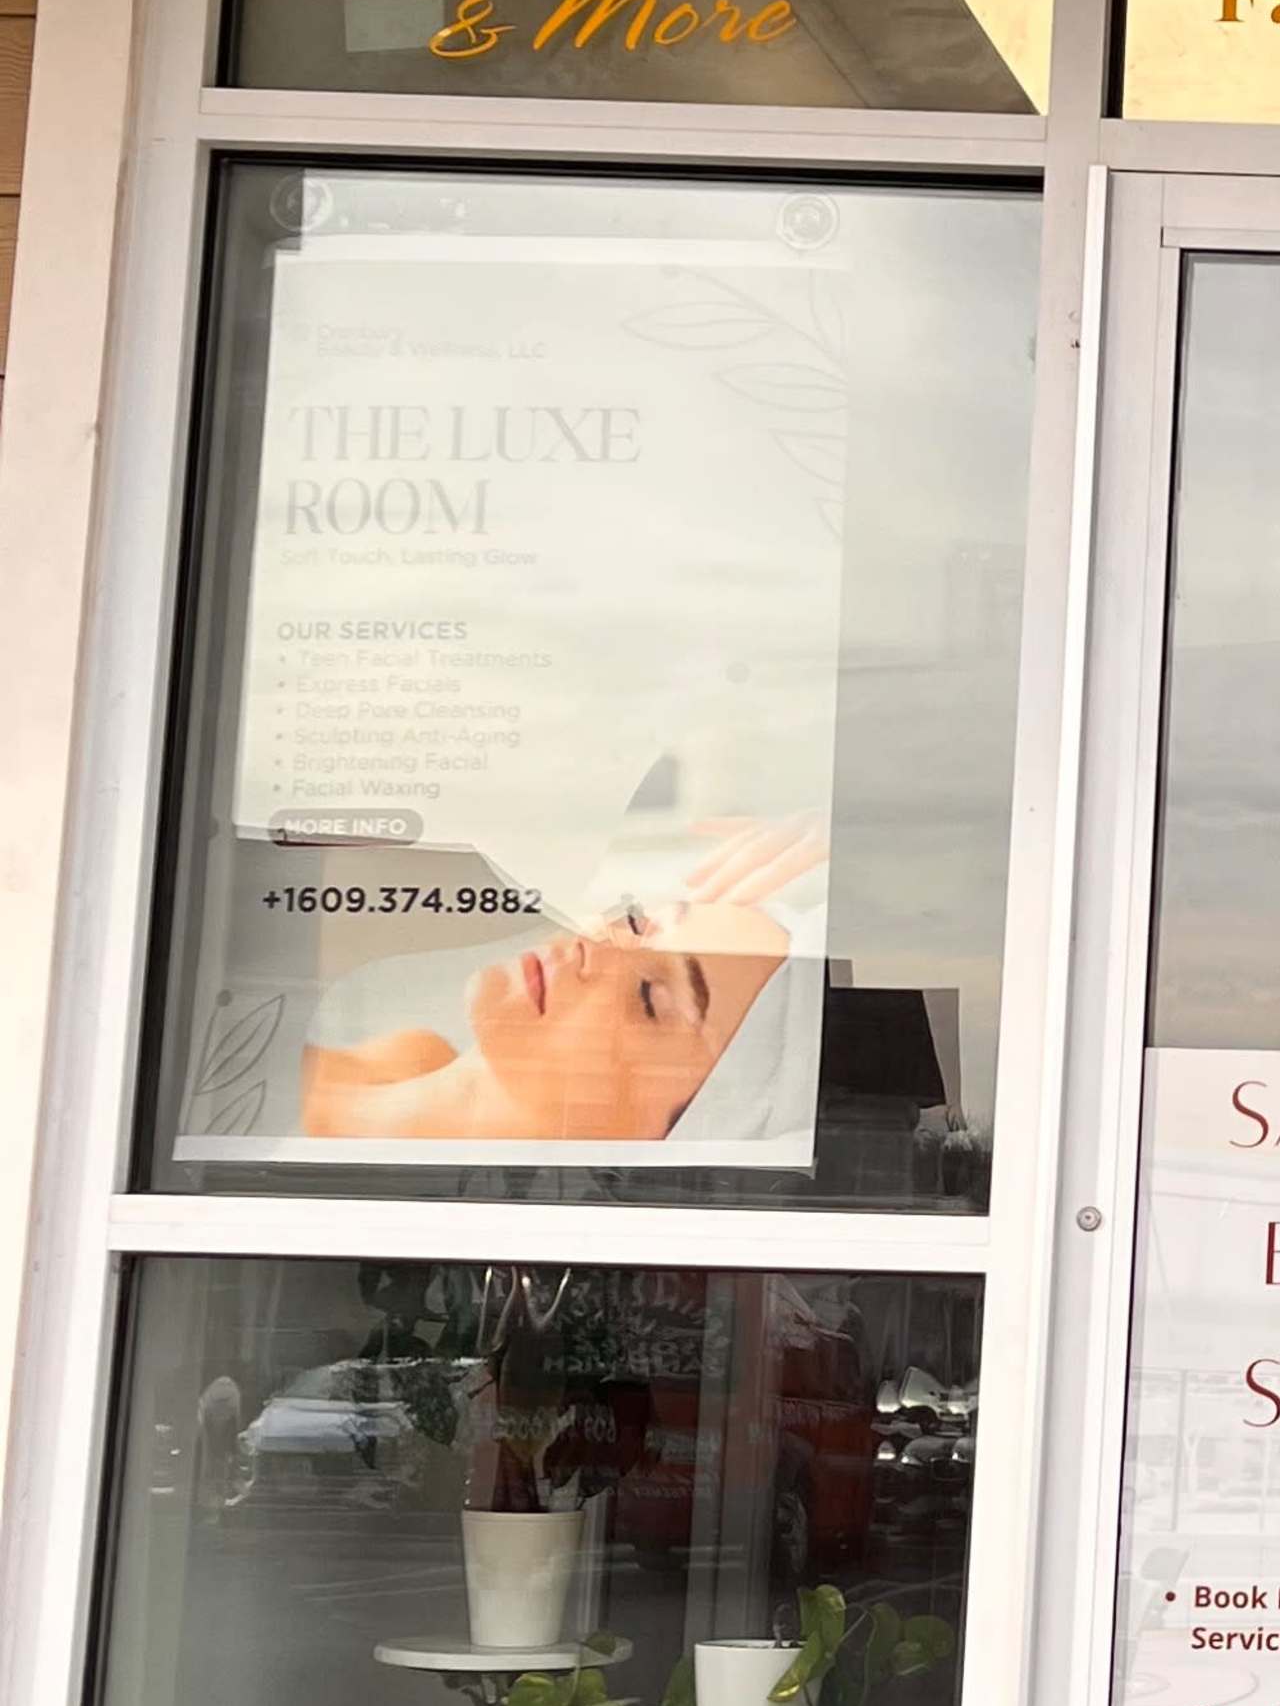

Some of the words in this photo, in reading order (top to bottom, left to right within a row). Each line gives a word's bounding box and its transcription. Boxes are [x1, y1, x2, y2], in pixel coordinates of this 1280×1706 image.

[293, 405, 430, 462] THE
[451, 405, 642, 463] LUXE
[286, 479, 491, 535] ROOM
[277, 622, 331, 640] OUR
[338, 621, 467, 640] SERVICES
[356, 649, 420, 667] Facial
[427, 650, 552, 668] Treatments
[296, 675, 379, 694] Express
[387, 675, 461, 693] Facials
[414, 701, 520, 724] Cleansing
[402, 728, 520, 750] Anti-Aging
[425, 753, 488, 770] Facial
[292, 779, 354, 797] Facial
[360, 779, 441, 799] Waxing
[352, 818, 407, 835] INFO
[263, 887, 543, 915] +1609.374.9882
[1194, 1586, 1267, 1609] Book
